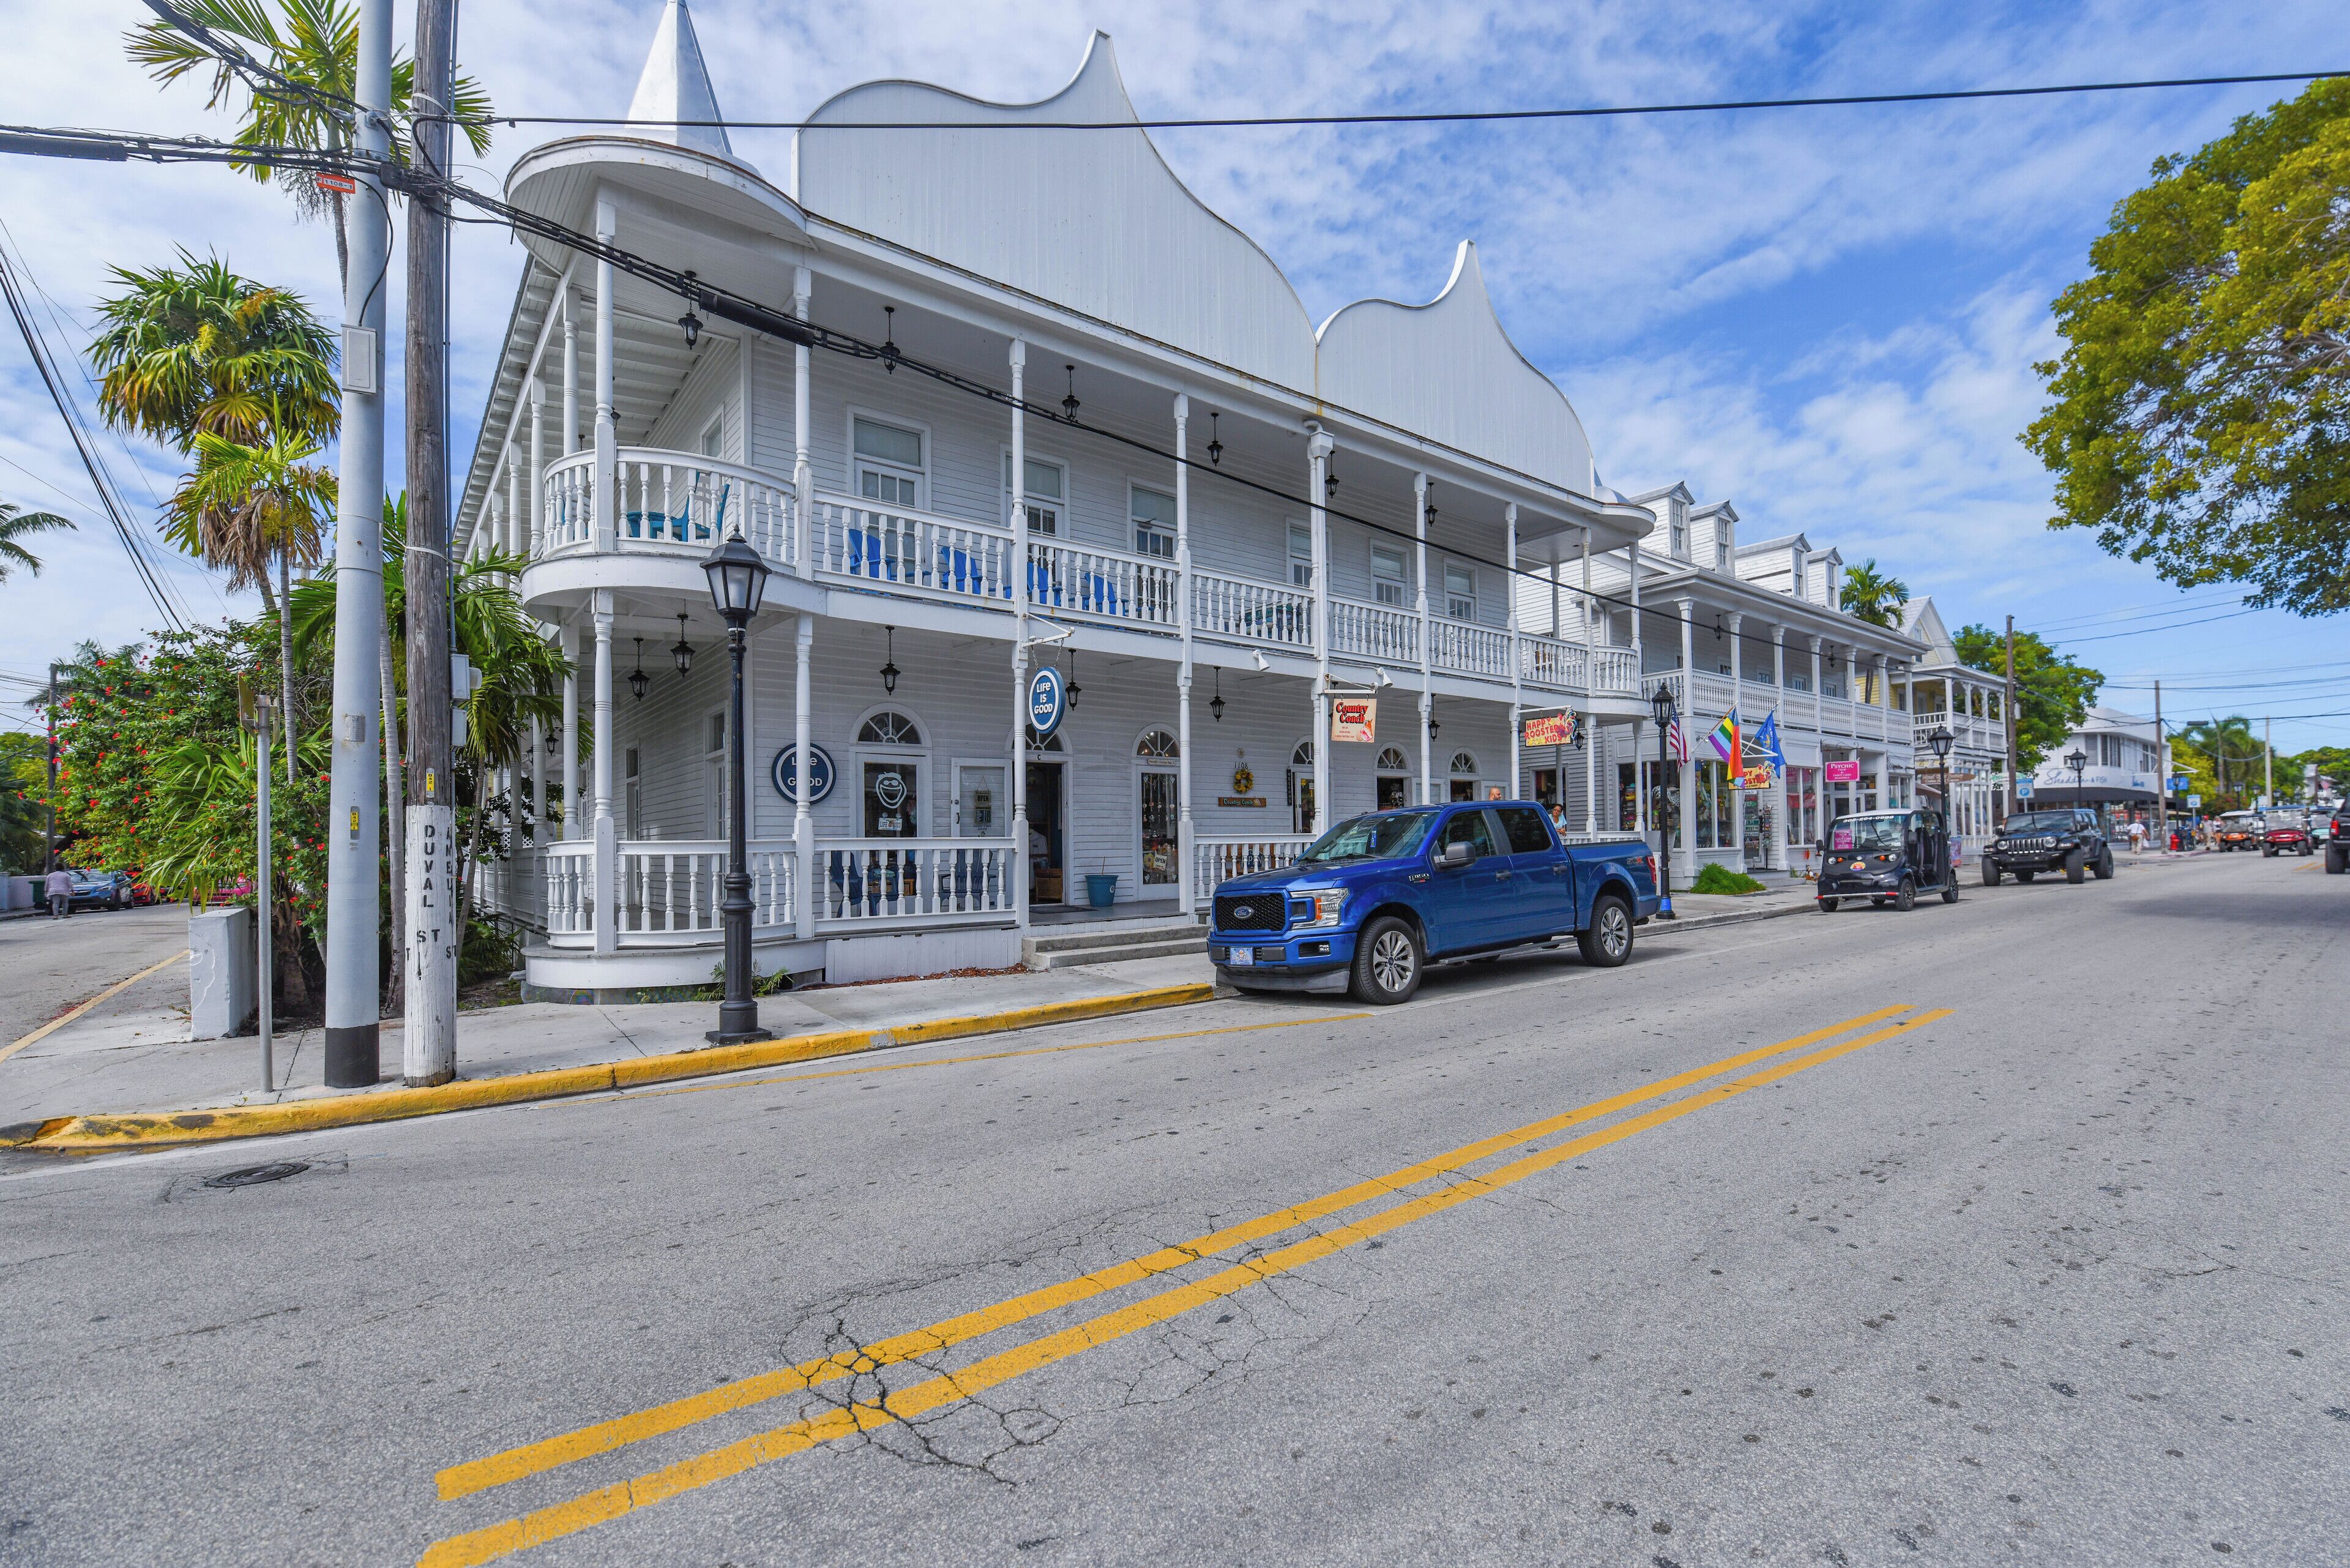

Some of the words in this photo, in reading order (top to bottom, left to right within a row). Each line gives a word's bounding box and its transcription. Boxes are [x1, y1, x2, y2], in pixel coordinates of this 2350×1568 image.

[324, 179, 352, 190] 1108-1
[1040, 693, 1047, 703] IS
[1034, 703, 1053, 714] GOOD
[1336, 702, 1369, 714] Country
[1340, 712, 1365, 724] Conch
[1524, 724, 1559, 739] ROOSTER
[1544, 733, 1562, 744] KIDS
[791, 756, 818, 766] Le
[788, 777, 822, 786] GOD
[423, 825, 435, 908] DUVAL
[417, 929, 440, 943] ST
